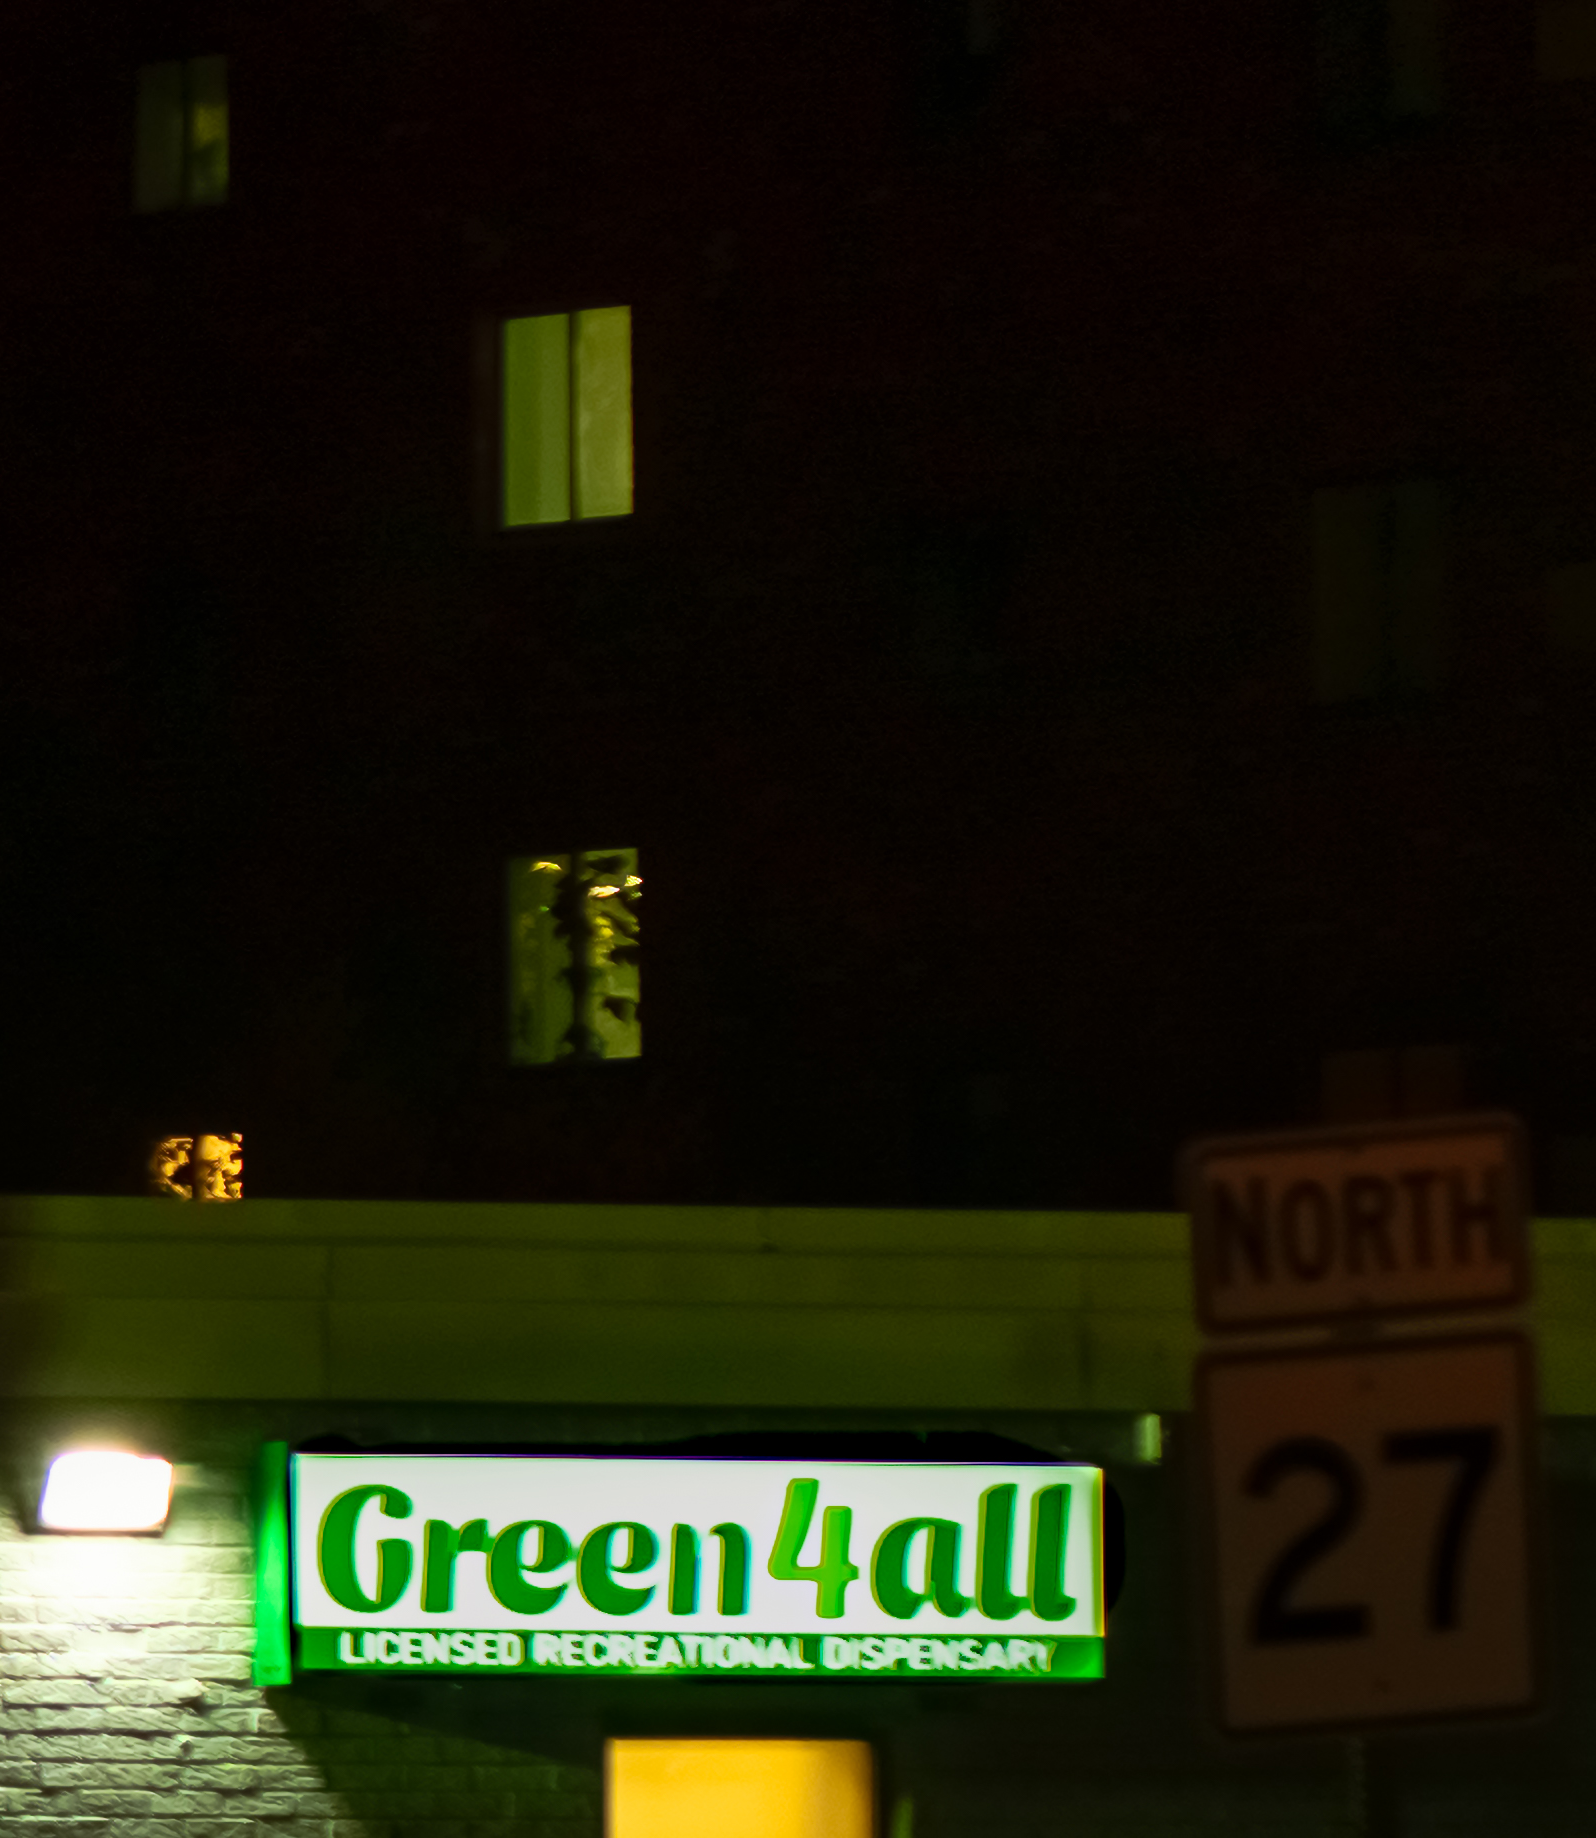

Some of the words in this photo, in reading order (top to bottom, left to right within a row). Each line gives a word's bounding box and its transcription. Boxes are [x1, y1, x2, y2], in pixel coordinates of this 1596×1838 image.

[1213, 1164, 1513, 1288] NORTH
[1241, 1423, 1501, 1647] 27
[338, 1629, 523, 1668] LICENSED
[533, 1632, 815, 1671] RECREATIONAL
[822, 1635, 1059, 1674] DISPENSARY
